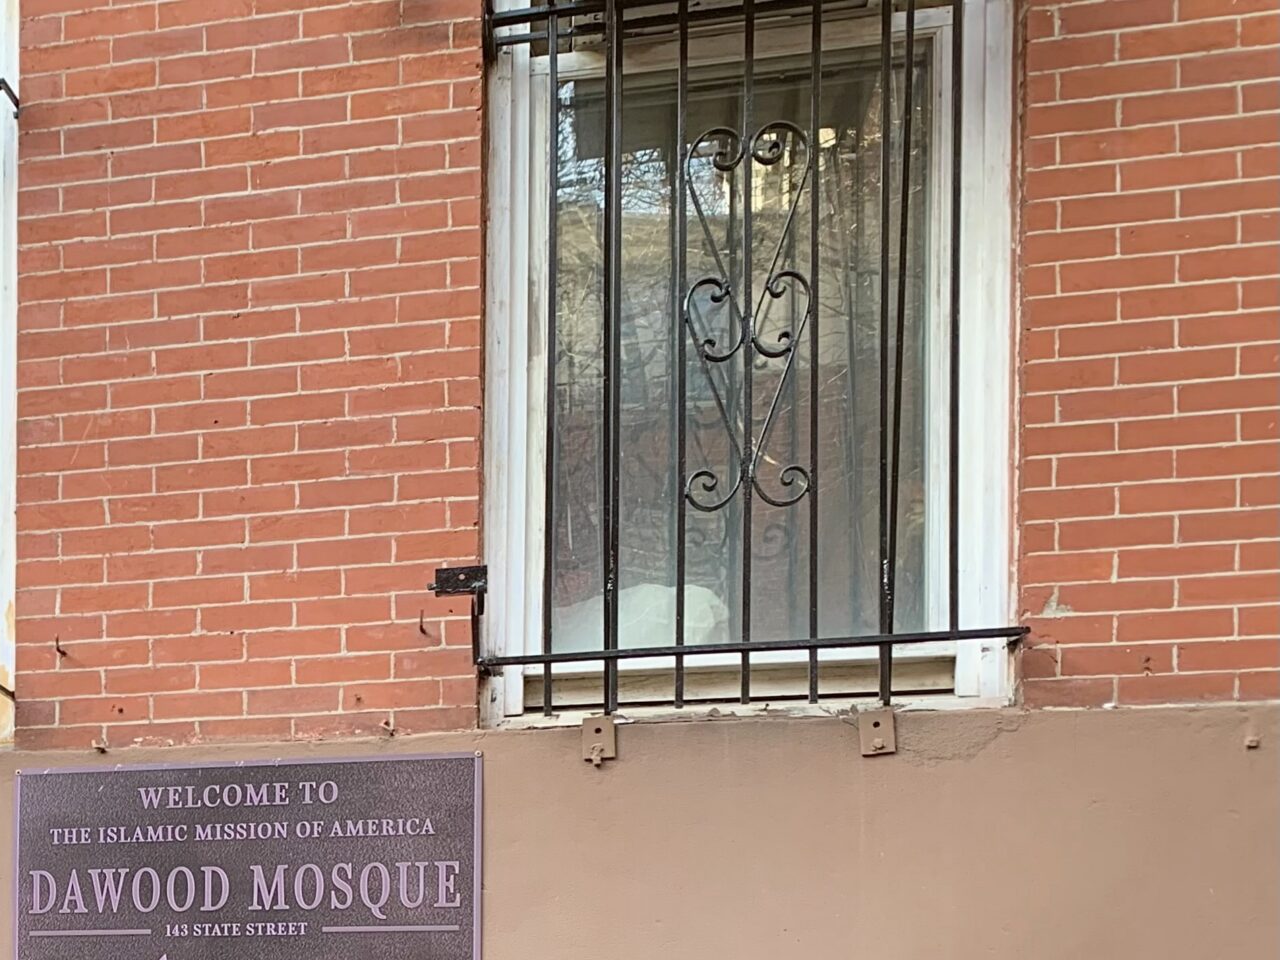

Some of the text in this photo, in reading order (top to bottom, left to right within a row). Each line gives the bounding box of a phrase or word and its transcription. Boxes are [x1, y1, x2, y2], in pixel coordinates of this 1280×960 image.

[139, 780, 339, 810] WELCOME TO
[50, 818, 435, 845] THE ISLAMIC MISSION OF AMERICA
[29, 860, 461, 920] DAWOOD MOSQUE
[164, 922, 308, 937] 143 STATE STREET
